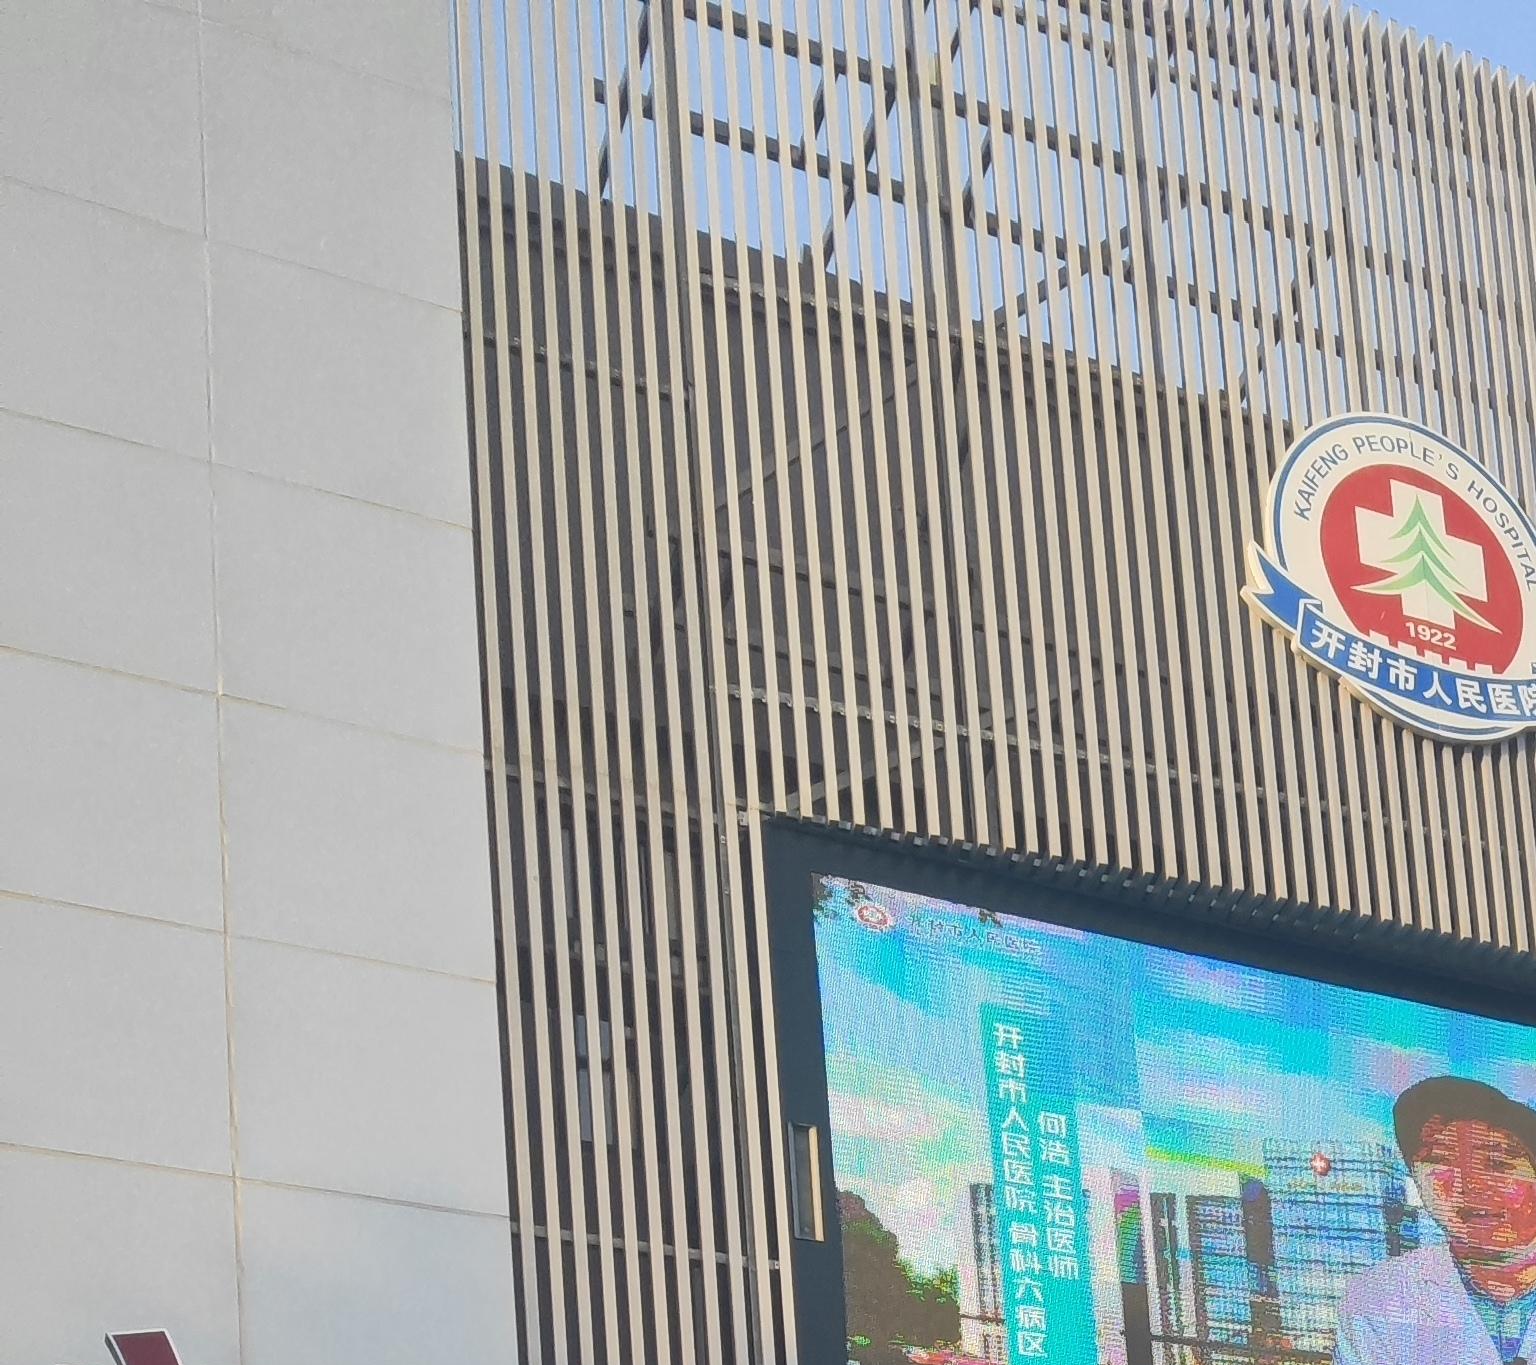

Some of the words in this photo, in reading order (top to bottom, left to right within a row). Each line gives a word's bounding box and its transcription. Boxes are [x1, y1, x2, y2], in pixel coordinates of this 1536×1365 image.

[1294, 443, 1349, 521] KAIFENG
[1352, 434, 1459, 480] PEOPLE'S
[1405, 621, 1457, 650] 1922
[994, 1023, 1038, 1214] 开封市人民医院
